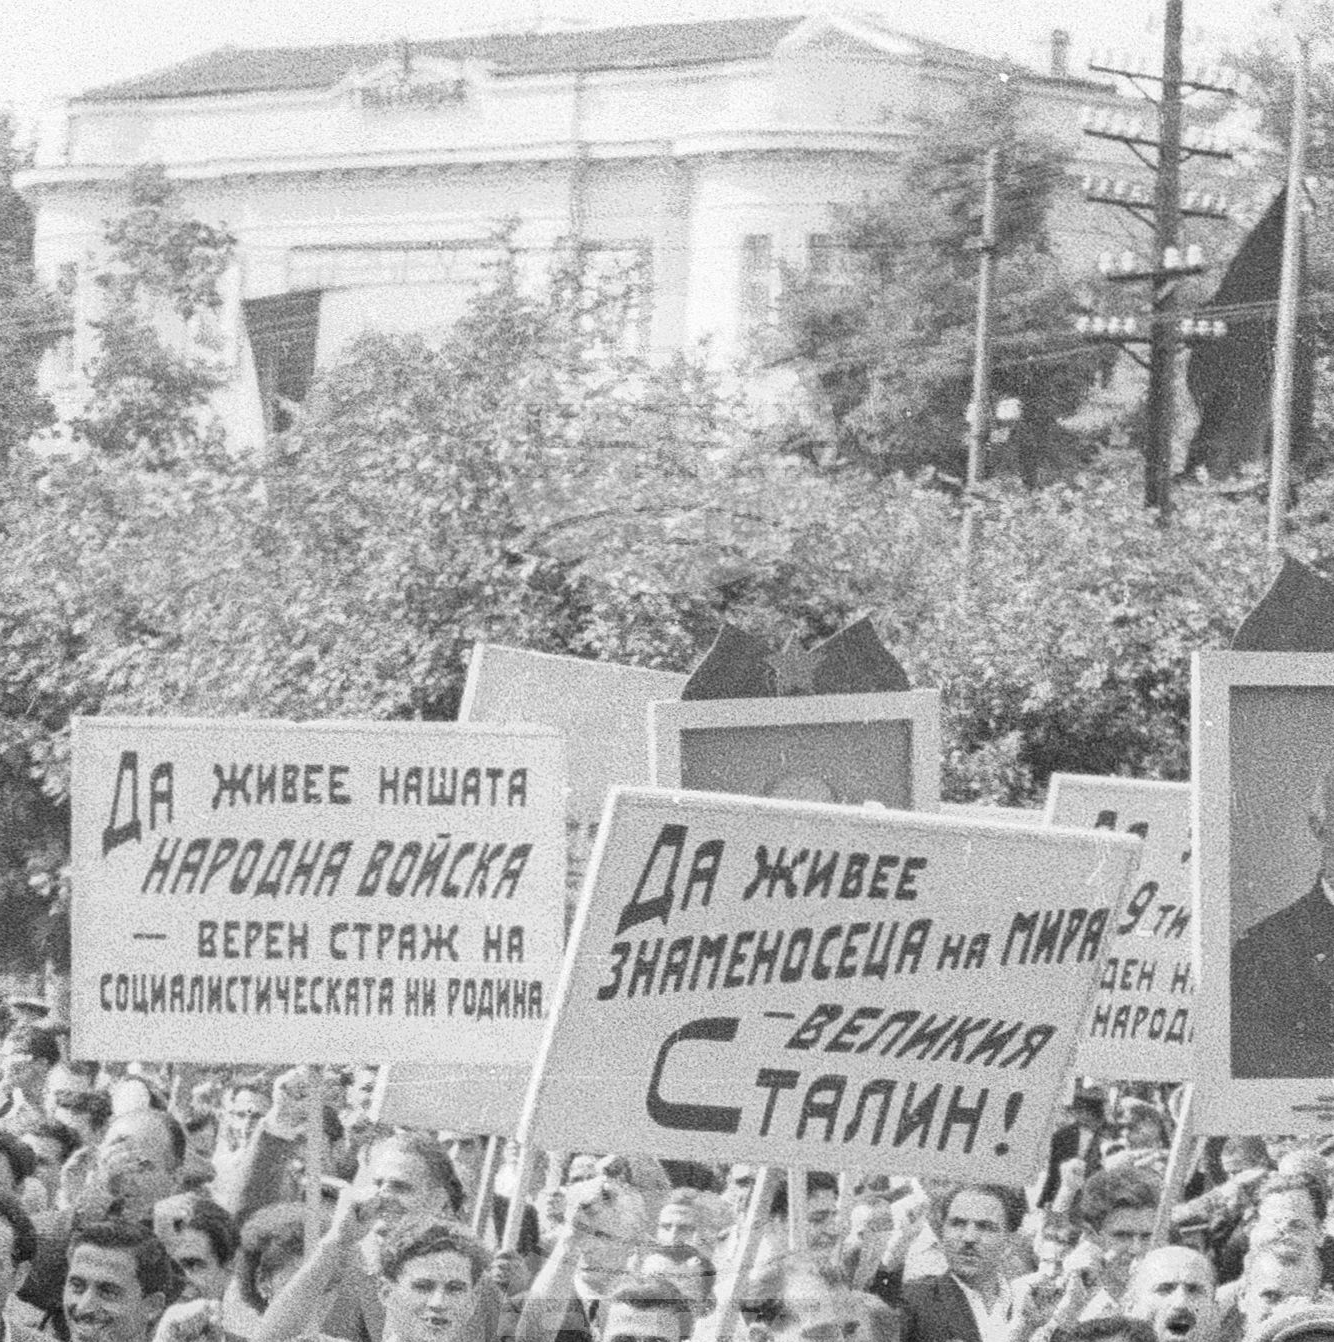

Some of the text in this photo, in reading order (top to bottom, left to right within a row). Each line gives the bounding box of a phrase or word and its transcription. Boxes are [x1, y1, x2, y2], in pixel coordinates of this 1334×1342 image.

[102, 750, 528, 858] ДА ЖИВЕЕ НАШАТА
[141, 837, 355, 898] НАРОДНА
[356, 832, 533, 899] ВОЙСКА
[616, 824, 725, 935] ДА
[743, 845, 927, 901] ЖИВЕЕ
[198, 920, 309, 960] ВЕРЕН
[329, 922, 460, 961] СТРАЖ
[483, 925, 525, 962] НА
[597, 918, 934, 1001] ЗНАМЕНОСЕЦА
[1001, 908, 1110, 966] МИРА
[99, 973, 394, 1016] СОЦИАЛИСТИЧЕСКАТА
[405, 978, 437, 1016] НИ
[1100, 957, 1195, 995] ДЕН Н
[1090, 1004, 1195, 1045] НАРОД
[646, 1016, 1026, 1156] СТАЛИН!
